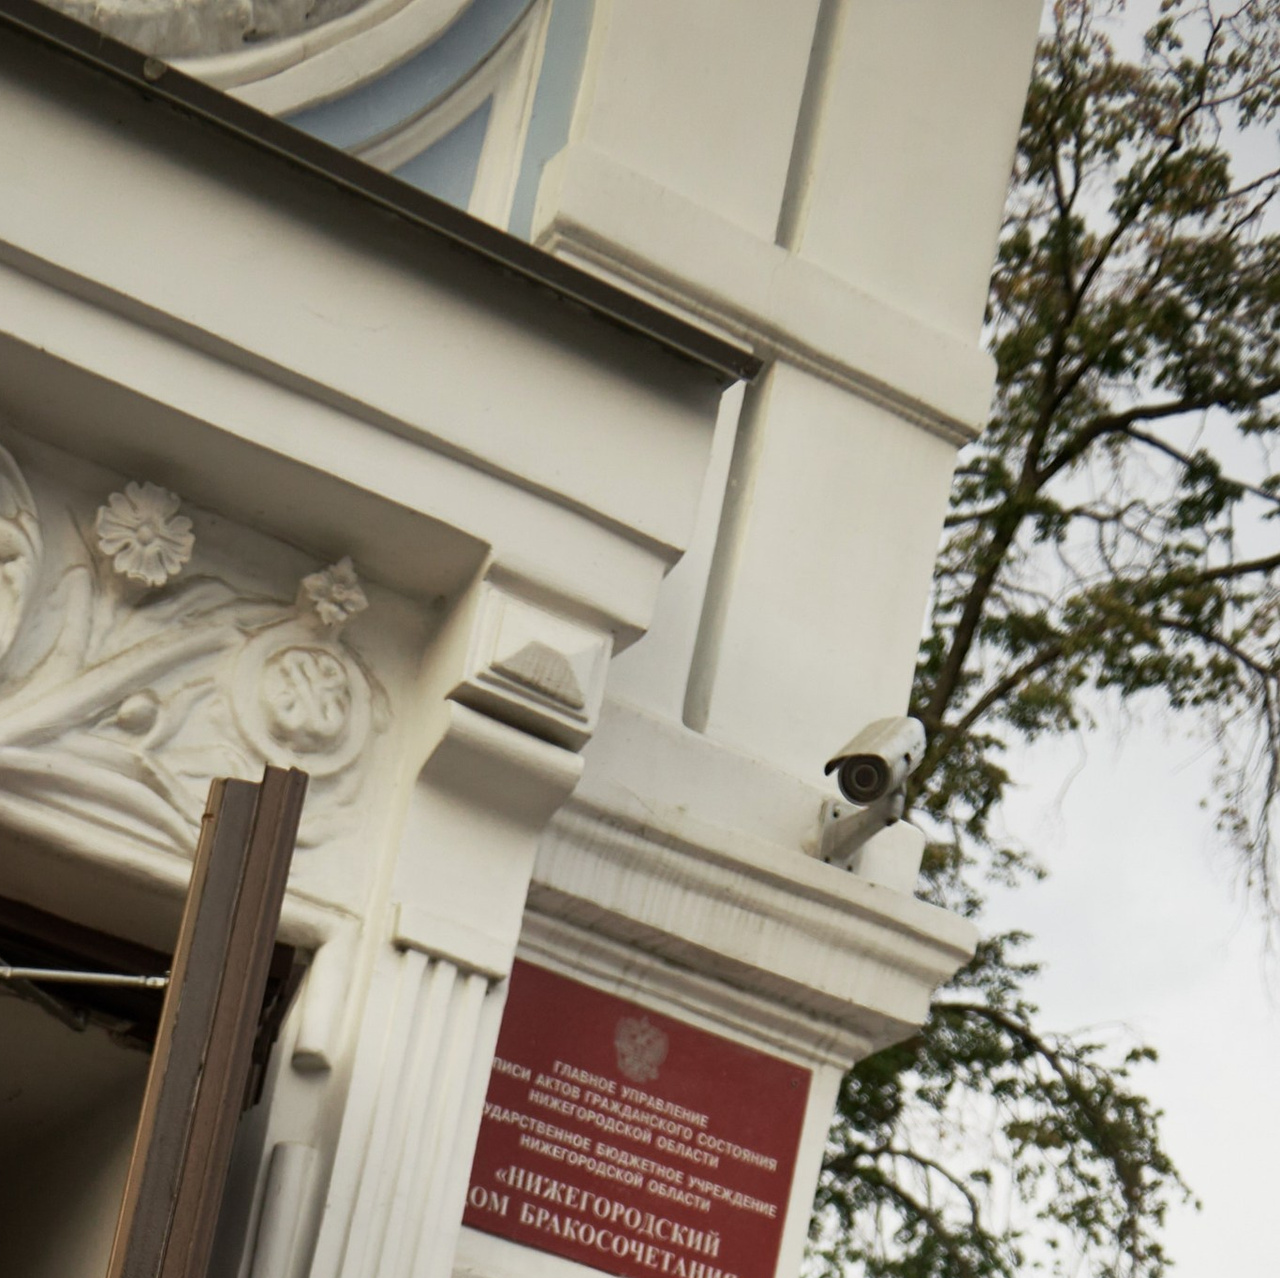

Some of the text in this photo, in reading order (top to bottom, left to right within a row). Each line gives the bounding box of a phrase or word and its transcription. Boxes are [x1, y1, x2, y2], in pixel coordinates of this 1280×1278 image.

[492, 1056, 778, 1172] ПИСИ АКТОВ ГРАЖДАНСКОГО СОСТОЯНИЯ
[528, 1088, 719, 1168] НИЖЕГОРОДСКОЙ ОБЛАСТИ
[553, 1060, 709, 1128] ГЛАВНОЕ УПРАВЛЕНИЕ
[483, 1101, 778, 1218] УДАРСТВЕННОЕ БЮДЖЕТНОЕ УЧРЕЖДЕНИЕ
[520, 1134, 711, 1213] НИЖЕГОРОДСКОЙ ОБЛАСТИ
[466, 1185, 510, 1217] ОМ
[494, 1165, 720, 1258] «НИЖЕГОРОДСКИЙ
